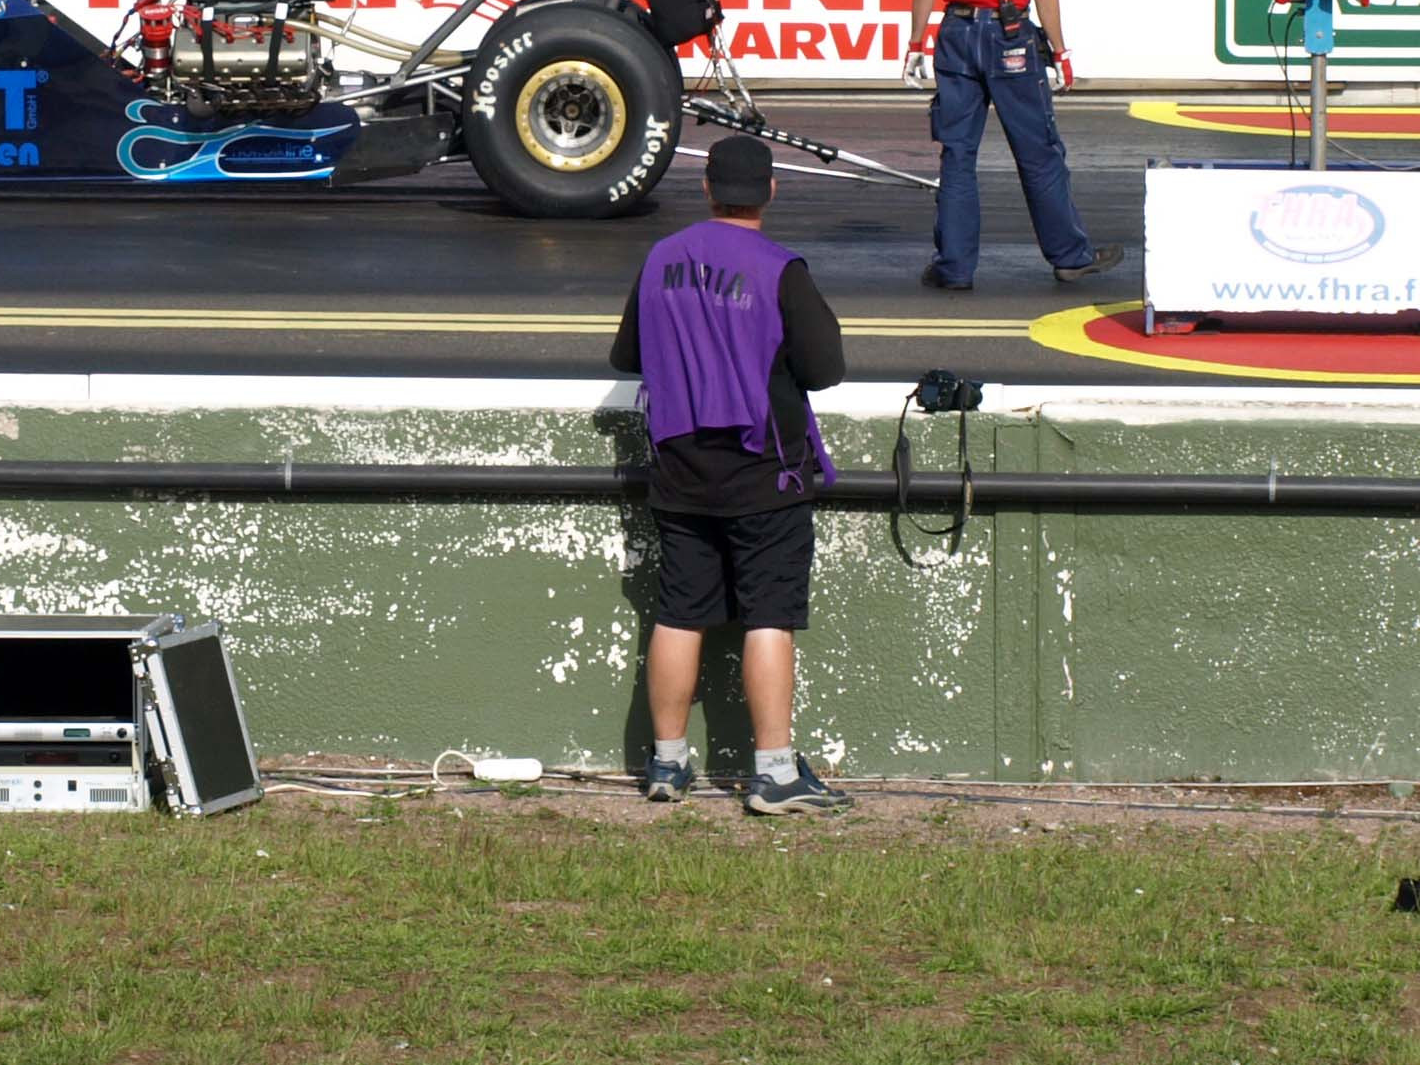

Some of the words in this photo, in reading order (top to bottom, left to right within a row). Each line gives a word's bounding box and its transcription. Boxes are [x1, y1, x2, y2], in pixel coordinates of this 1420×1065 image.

[26, 94, 38, 130] GmbH
[471, 31, 533, 120] Hoosier
[608, 114, 671, 202] Hoosier
